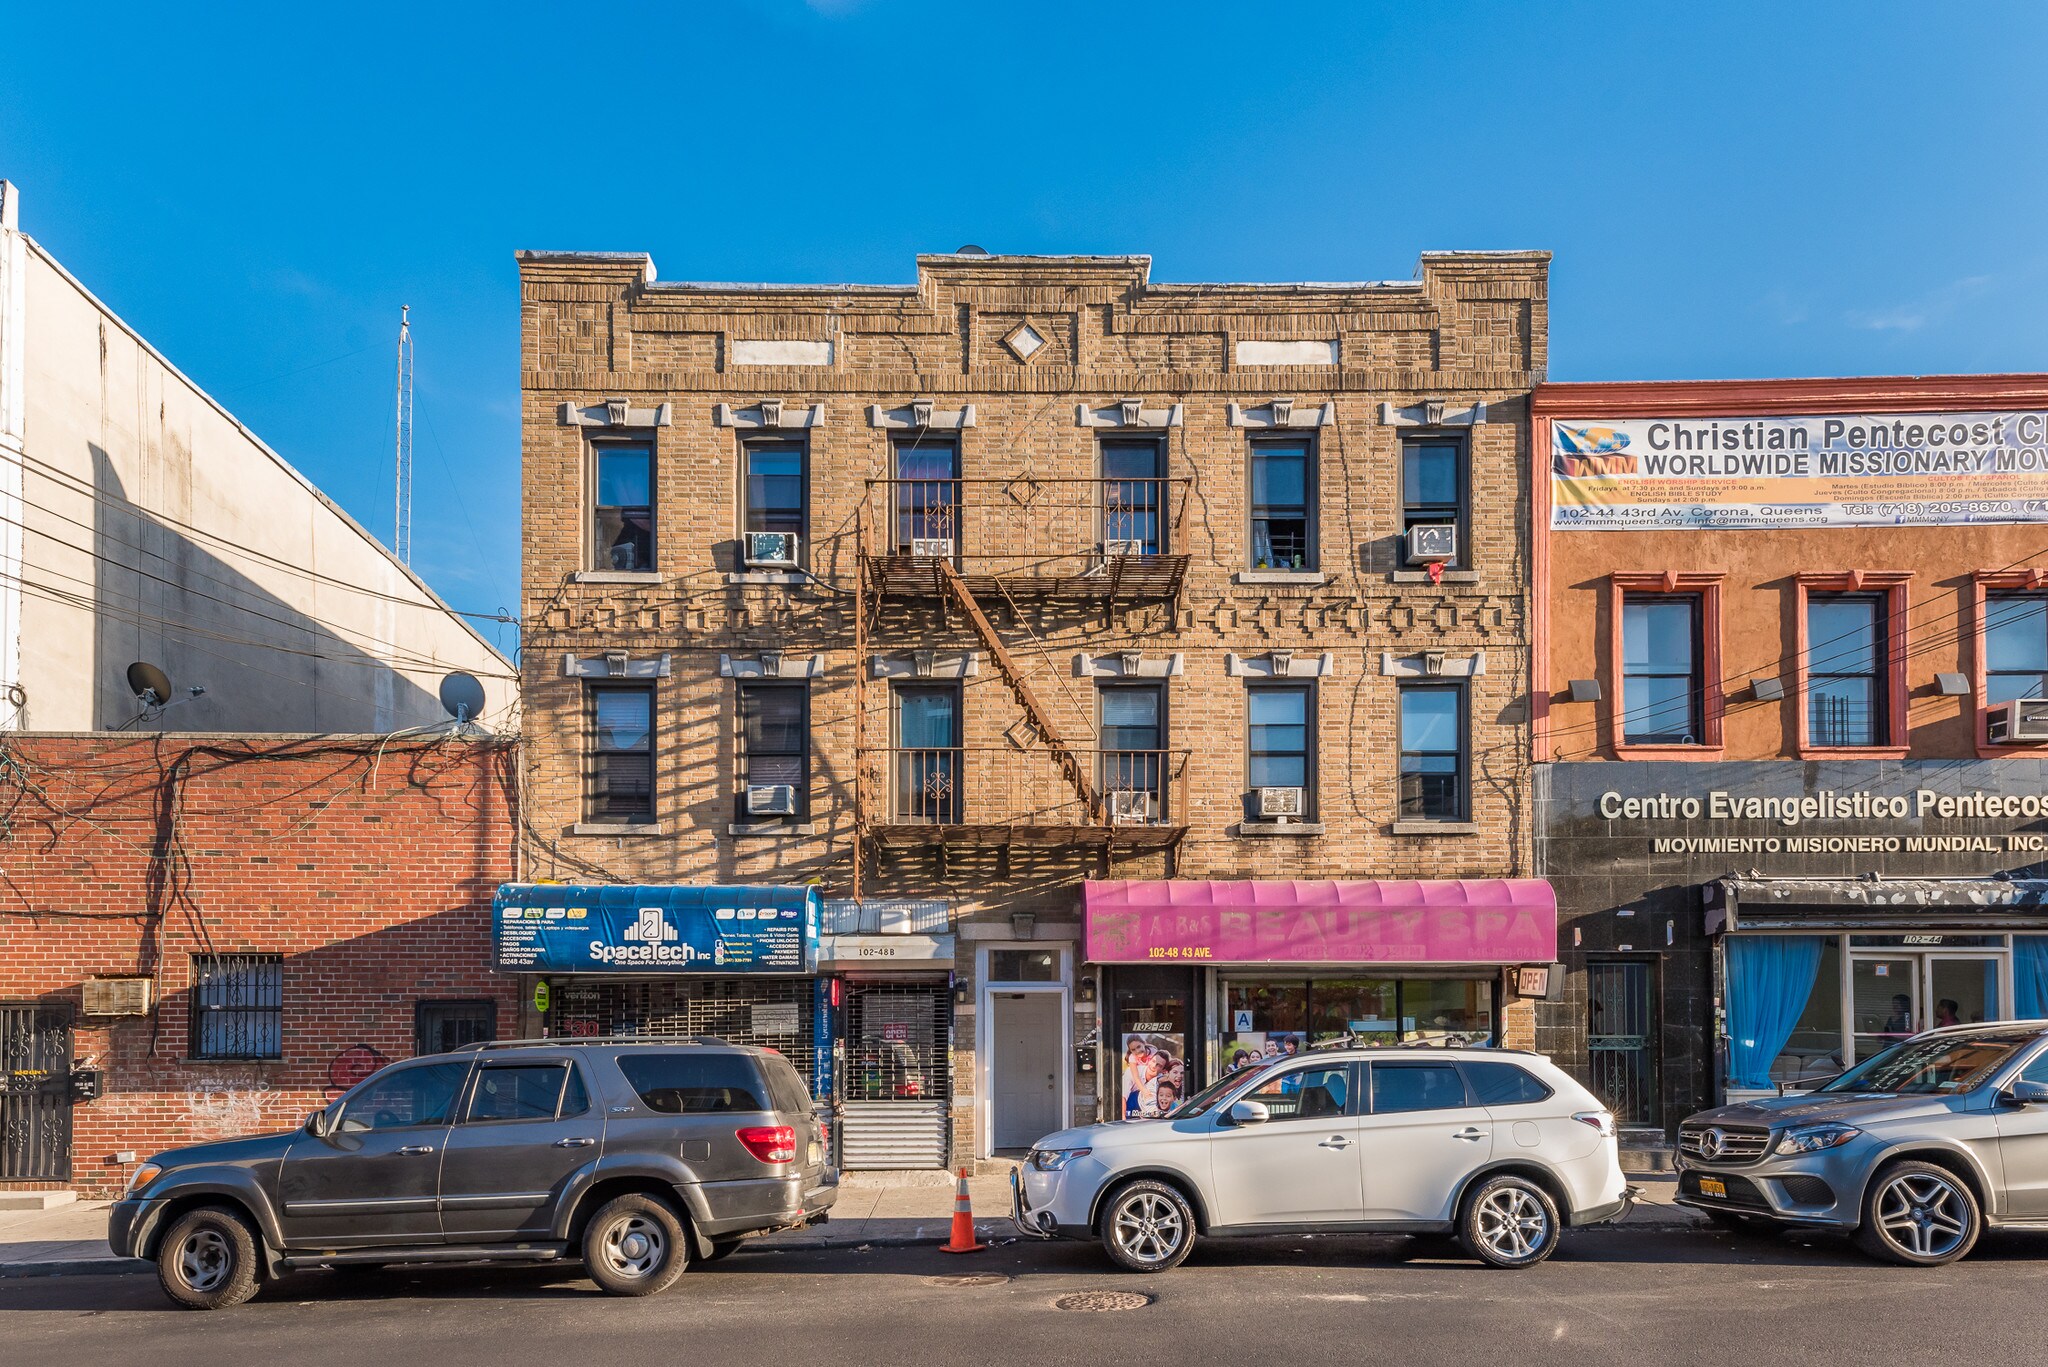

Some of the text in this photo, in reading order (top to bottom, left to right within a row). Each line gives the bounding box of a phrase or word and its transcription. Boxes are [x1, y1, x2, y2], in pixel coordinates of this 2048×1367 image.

[1648, 422, 1808, 450] Christian
[1824, 416, 2004, 448] Pentecost
[1644, 454, 1809, 475] WORLDWIDE
[1819, 449, 1988, 474] MISSIONARY
[1870, 487, 1937, 495] Congregacional)
[1560, 506, 1823, 518] 102-44 43rd Av. Corona, Queens
[1842, 503, 1874, 515] Tel:
[1878, 502, 1925, 517] (718)
[1929, 501, 2018, 514] 205-8670,
[1554, 518, 1683, 527] www.mmmqueens.org
[1694, 516, 1829, 525] info@mmmqueens.org
[1600, 791, 1700, 819] Centro
[1709, 790, 1908, 826] Evangelistico
[1654, 836, 2048, 854] MOVIMIENTO MISIONERO MUNDIAL, INC.
[1219, 912, 1425, 941] BEAUTY
[1438, 912, 1543, 941] SPA
[1905, 935, 1942, 944] 102-44
[589, 940, 711, 963] SpaceTech inc
[858, 948, 895, 956] 102-48B
[1149, 947, 1213, 958] 102-48 43 AVE.
[1520, 969, 1546, 992] OPEN
[564, 990, 600, 1000] verizon
[1238, 1012, 1250, 1026] A
[564, 1019, 598, 1037] $30
[1134, 1023, 1172, 1031] 102-48
